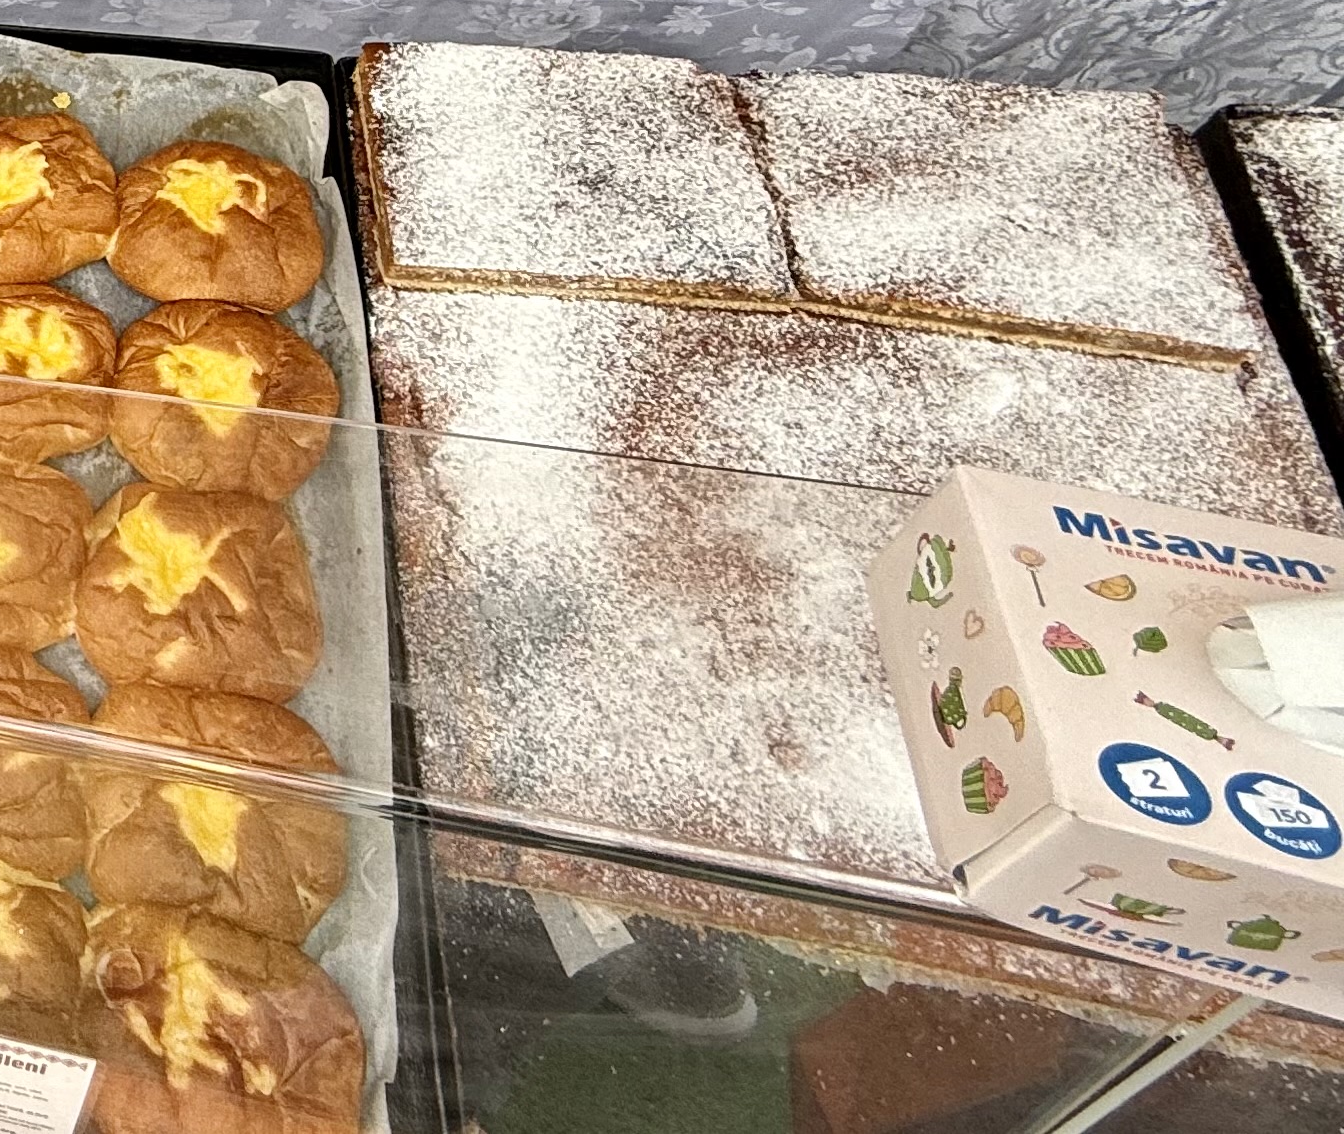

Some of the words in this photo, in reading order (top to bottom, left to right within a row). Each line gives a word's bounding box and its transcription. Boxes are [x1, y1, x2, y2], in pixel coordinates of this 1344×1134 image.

[1052, 505, 1327, 584] Misavan
[1106, 545, 1169, 565] TRECEM
[1172, 560, 1249, 580] ROMÂNIA
[1252, 573, 1275, 586] PE
[1141, 769, 1168, 791] 2
[1129, 797, 1195, 819] straturi
[1269, 807, 1313, 825] 150
[1028, 904, 1291, 984] Misavan
